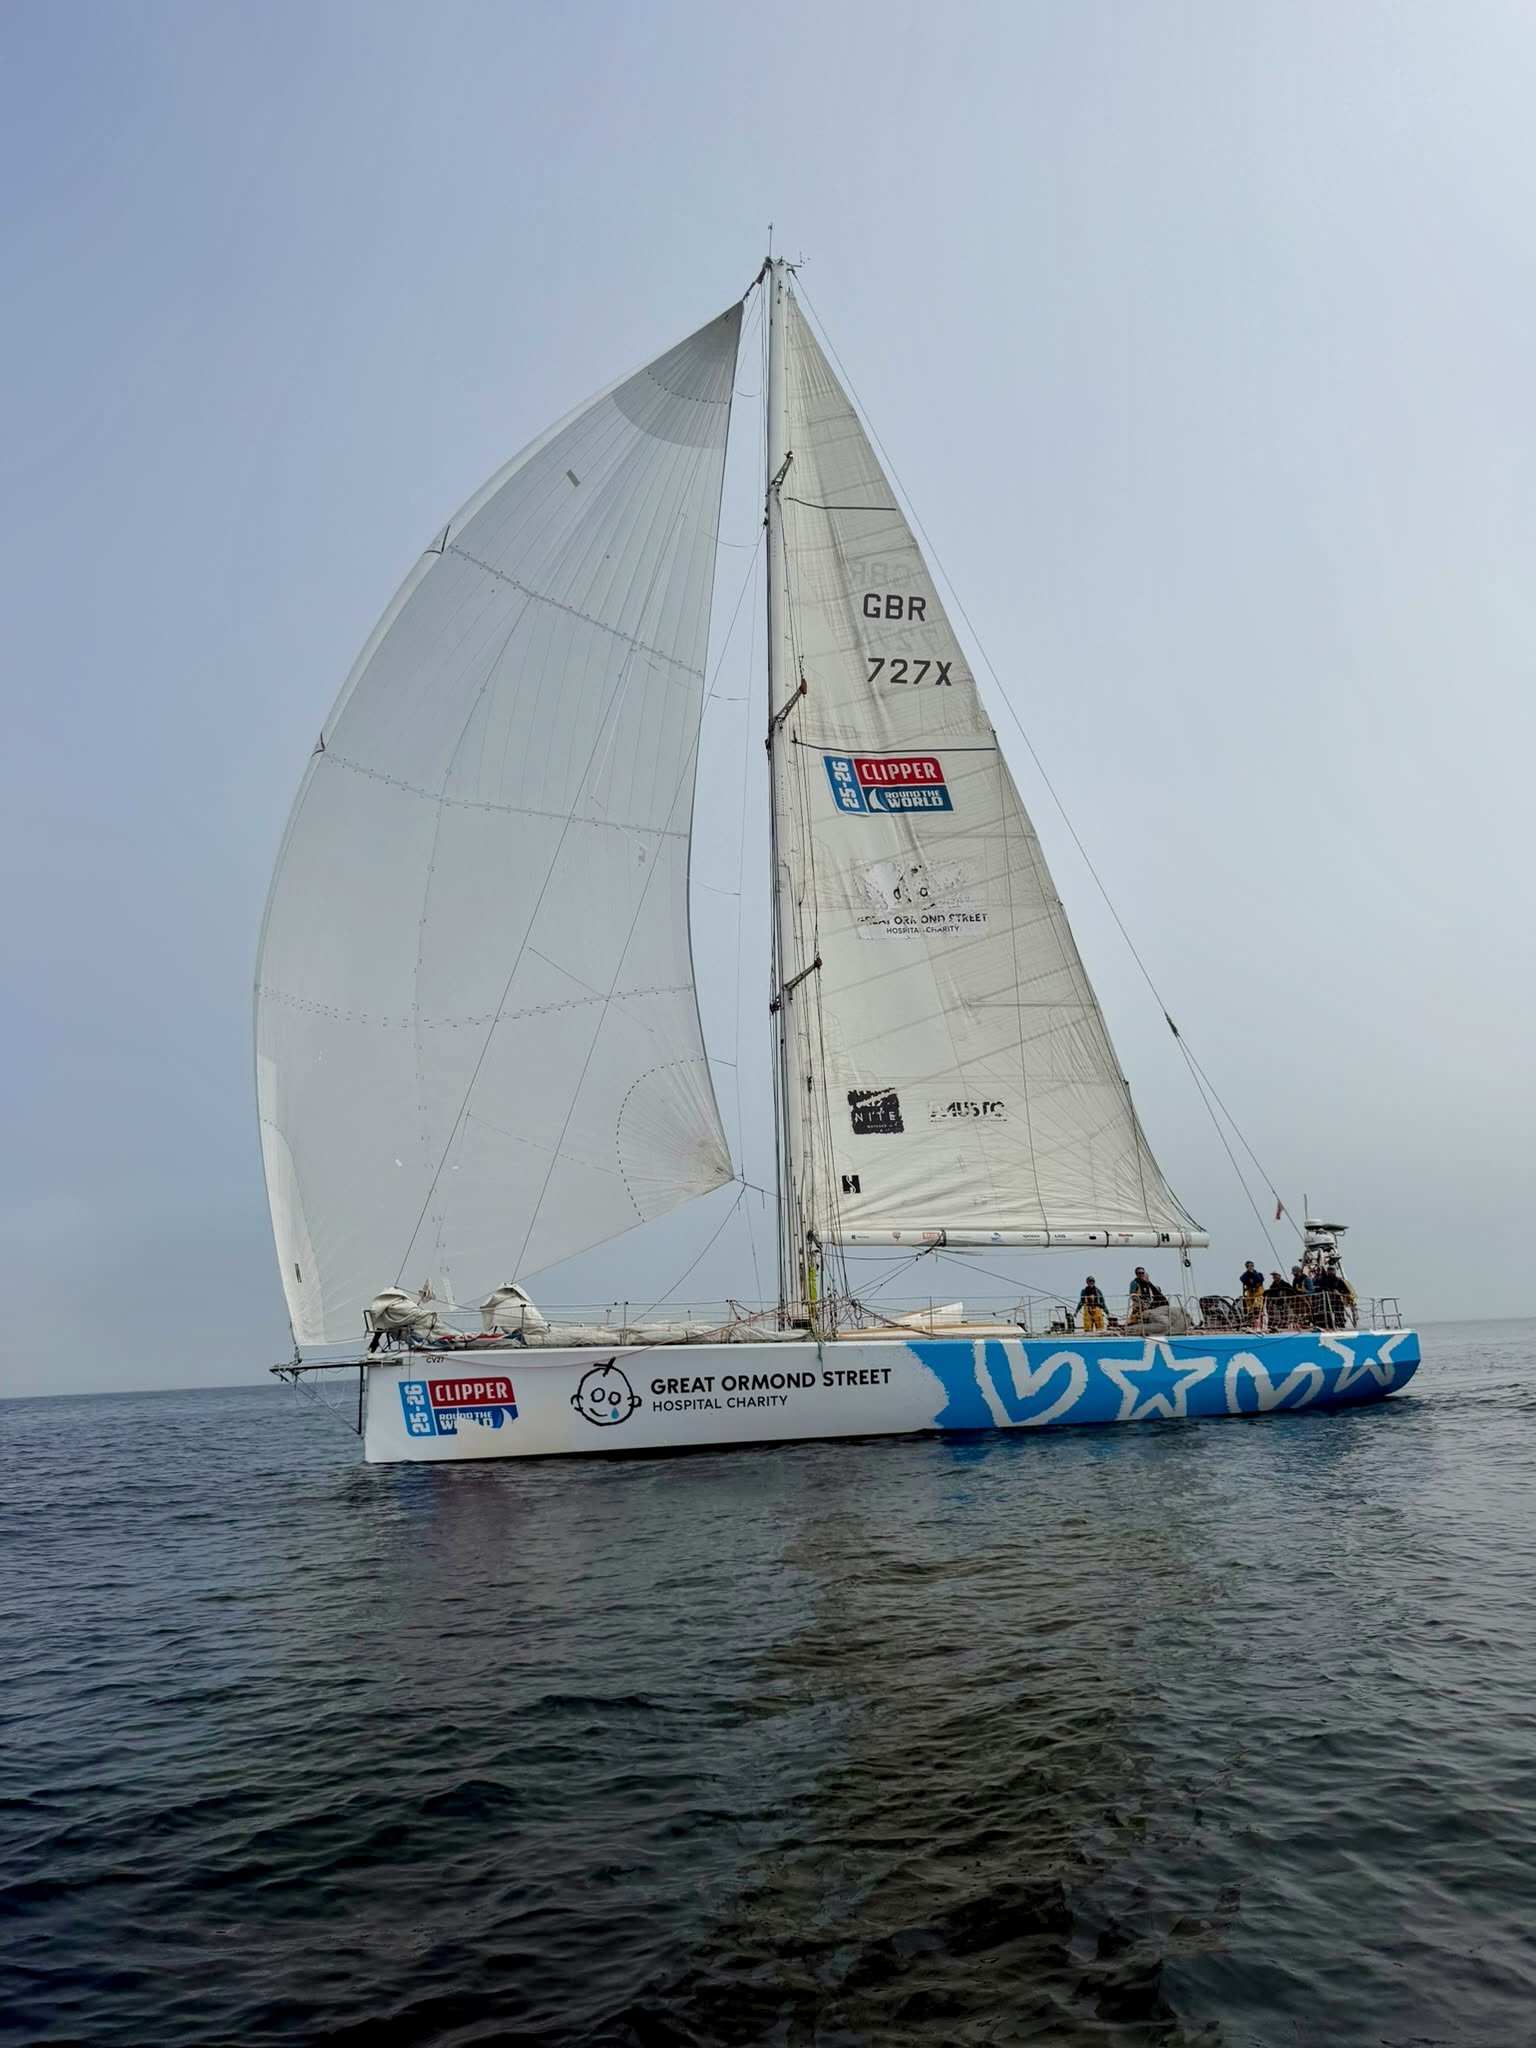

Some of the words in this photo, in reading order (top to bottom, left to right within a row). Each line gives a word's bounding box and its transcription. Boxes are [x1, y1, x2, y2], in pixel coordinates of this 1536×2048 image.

[863, 593, 926, 622] GBR
[867, 657, 952, 686] 727X
[861, 762, 938, 780] CLIPPER
[832, 760, 860, 809] 25-26
[884, 791, 921, 799] ROUND
[886, 797, 944, 808] WORLD
[435, 1382, 509, 1402] CLIPPER
[650, 1376, 715, 1395] GREAT
[721, 1372, 815, 1392] ORMOND
[823, 1368, 892, 1387] STREET
[404, 1384, 431, 1433] 25-26
[652, 1397, 722, 1412] HOSPITAL
[726, 1395, 788, 1409] CHARITY
